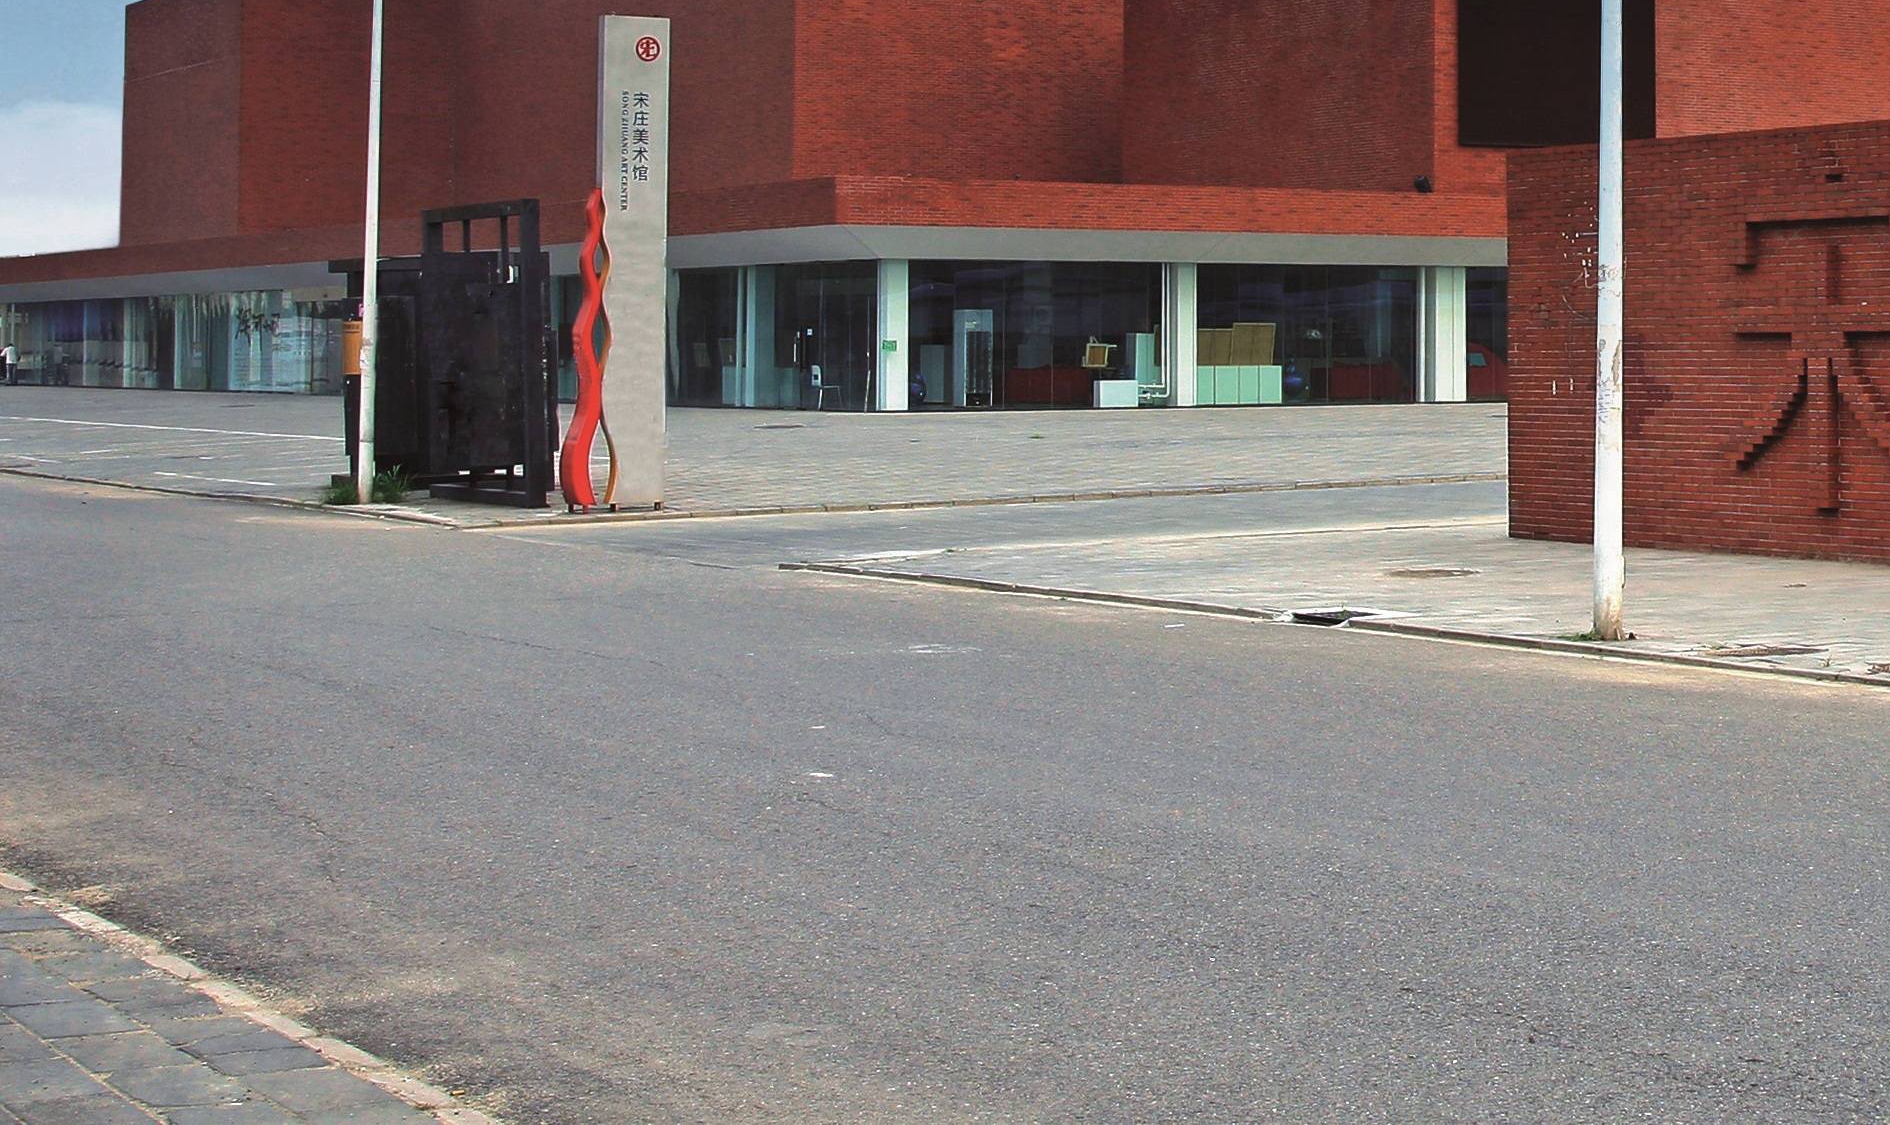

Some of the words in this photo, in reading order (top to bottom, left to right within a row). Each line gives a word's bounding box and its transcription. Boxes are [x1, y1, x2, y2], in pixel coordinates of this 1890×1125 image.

[621, 90, 630, 116] SONG
[632, 92, 649, 181] 宋庄美术馆
[620, 156, 629, 174] ART
[620, 175, 628, 211] CENTER
